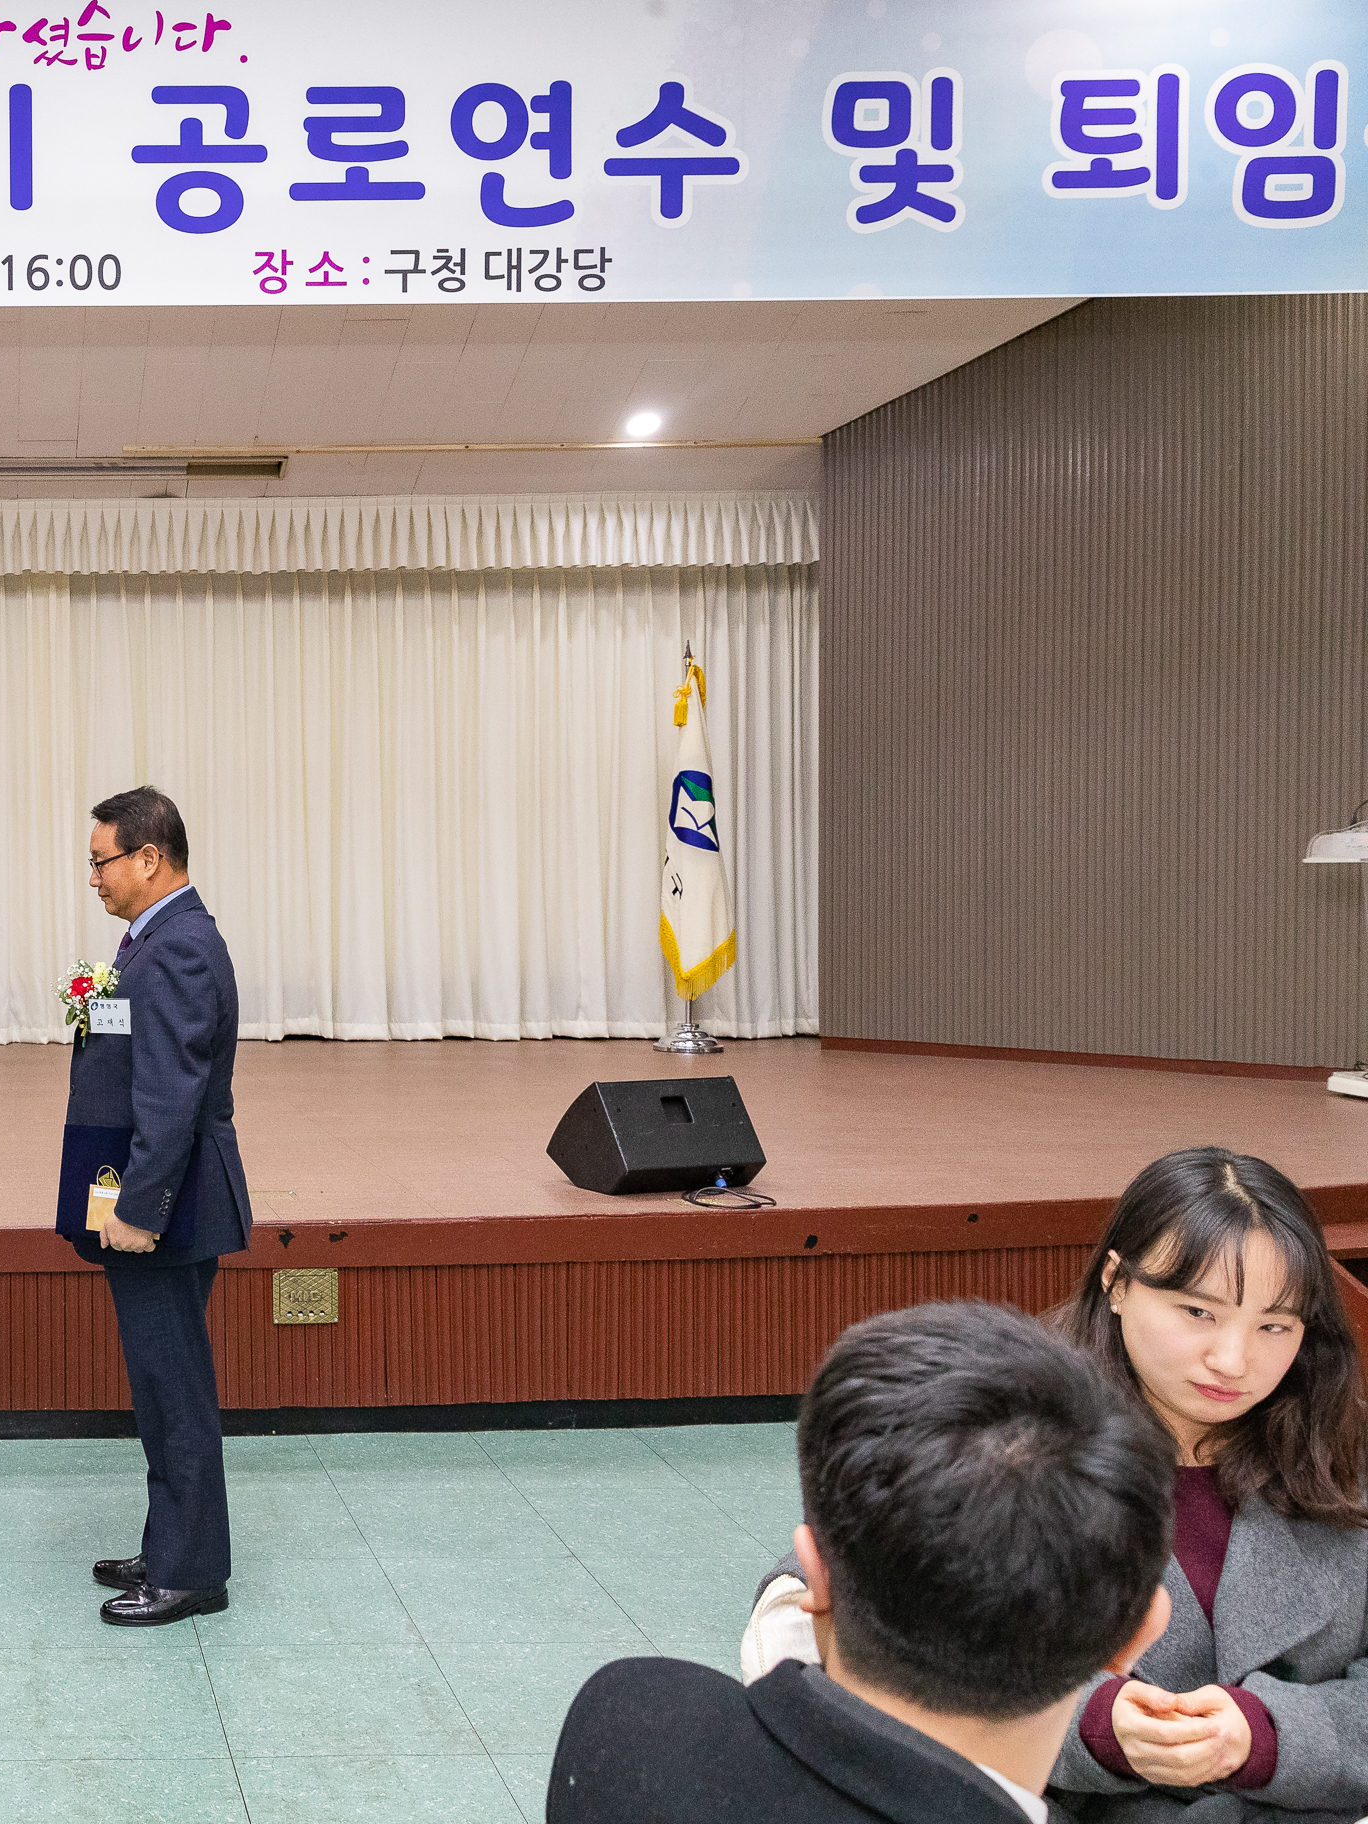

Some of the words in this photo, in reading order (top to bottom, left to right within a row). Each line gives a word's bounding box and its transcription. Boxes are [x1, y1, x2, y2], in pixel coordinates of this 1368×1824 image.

[131, 80, 740, 235] 공로연수
[831, 76, 957, 225] 및
[1, 253, 122, 291] 16:00
[384, 247, 466, 293] 구청
[484, 246, 613, 293] 대강당
